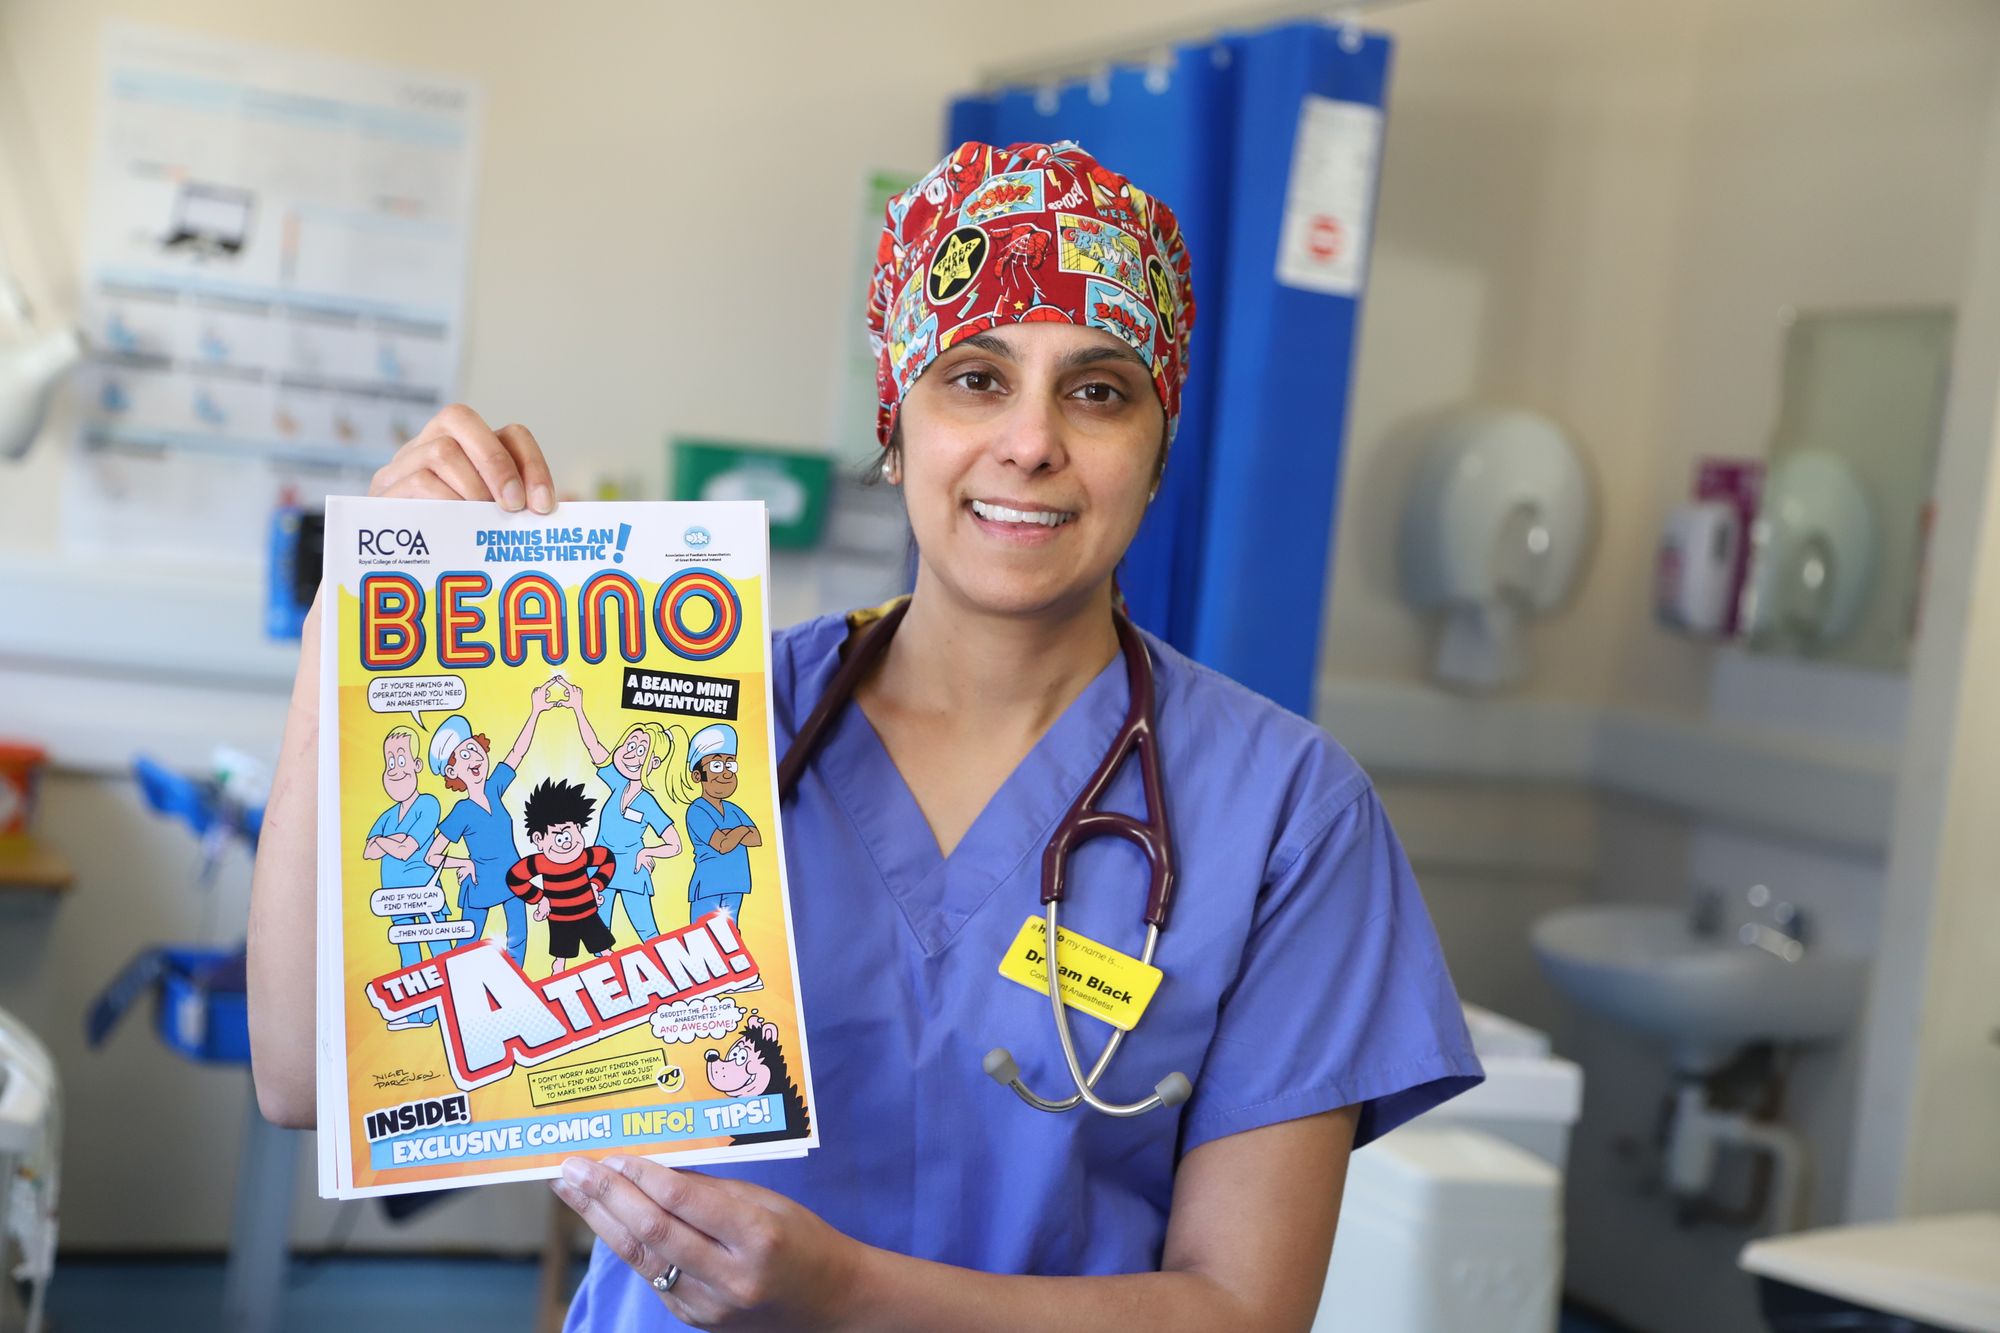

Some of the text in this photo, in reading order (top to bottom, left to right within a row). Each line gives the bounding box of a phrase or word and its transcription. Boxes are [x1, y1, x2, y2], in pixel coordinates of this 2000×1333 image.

[1047, 179, 1088, 210] SPIDEY
[1121, 221, 1148, 240] HEAD
[943, 254, 966, 276] MAN
[476, 527, 614, 546] DENNIS HAS AN
[360, 566, 743, 671] BEANO
[372, 690, 412, 699] OPERATION
[413, 690, 428, 698] AND
[380, 682, 388, 690] IF
[415, 681, 443, 689] HAVING
[626, 674, 733, 698] A BEANO MINI
[632, 691, 728, 715] ADVENTURE!
[435, 927, 450, 935] CAN
[1065, 939, 1081, 951] my
[1081, 945, 1107, 961] name
[382, 964, 445, 1003] THE
[541, 912, 751, 1032] TEAM!
[1025, 949, 1133, 1005] Dr am Black
[445, 941, 568, 1073] A
[1068, 986, 1114, 1011] Anaesthetist
[660, 1009, 687, 1019] GEDDIT?
[660, 1019, 734, 1033] AND AWESOME!
[674, 1012, 717, 1023] ANAESTHETIC
[537, 1074, 557, 1084] DON'T
[560, 1070, 583, 1079] WORRY
[585, 1065, 607, 1075] ABOUT
[609, 1059, 639, 1070] FINDING
[540, 1082, 566, 1092] THEY'LL
[568, 1078, 584, 1086] FIND
[603, 1071, 620, 1080] THAT
[621, 1068, 636, 1076] WAS
[638, 1065, 653, 1074] JUST
[557, 1088, 577, 1097] MAKE
[578, 1084, 597, 1093] THEM
[598, 1080, 621, 1090] SOUND
[622, 1074, 653, 1085] COOLER!
[366, 1095, 469, 1140] INSIDE!
[392, 1097, 771, 1165] EXCLUSIVE COMIC! INFO! TIPS!
